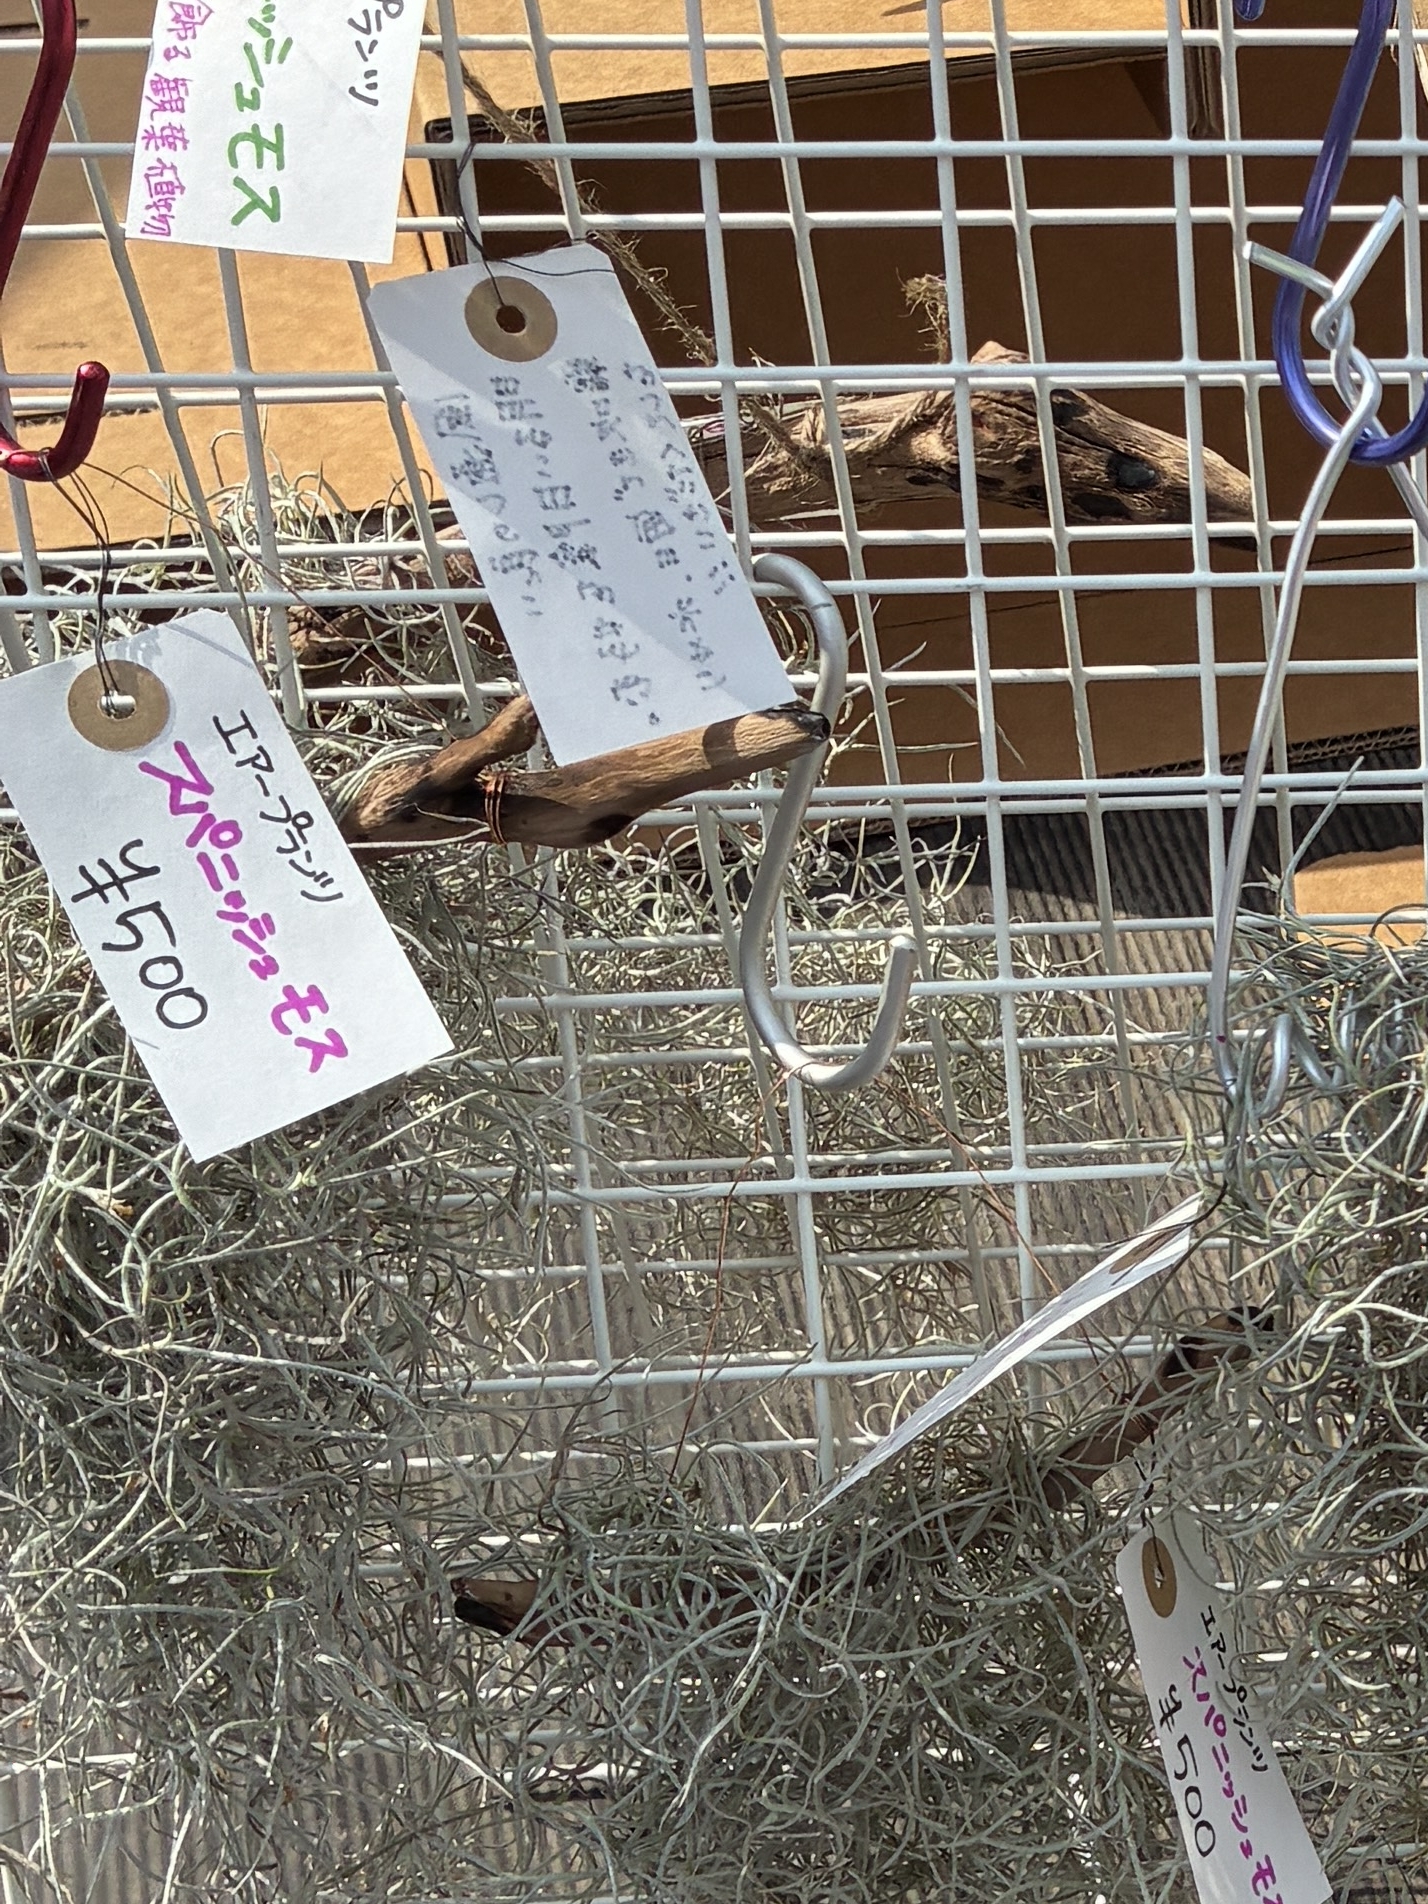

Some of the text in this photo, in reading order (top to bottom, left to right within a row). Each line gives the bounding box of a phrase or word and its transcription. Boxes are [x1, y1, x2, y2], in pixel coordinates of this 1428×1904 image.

[212, 709, 344, 902] エアープランツ
[71, 838, 209, 1030] ¥500
[138, 740, 349, 1073] スパニッシュモス
[1158, 1683, 1217, 1859] ¥500
[1201, 1604, 1269, 1773] エアープランツ
